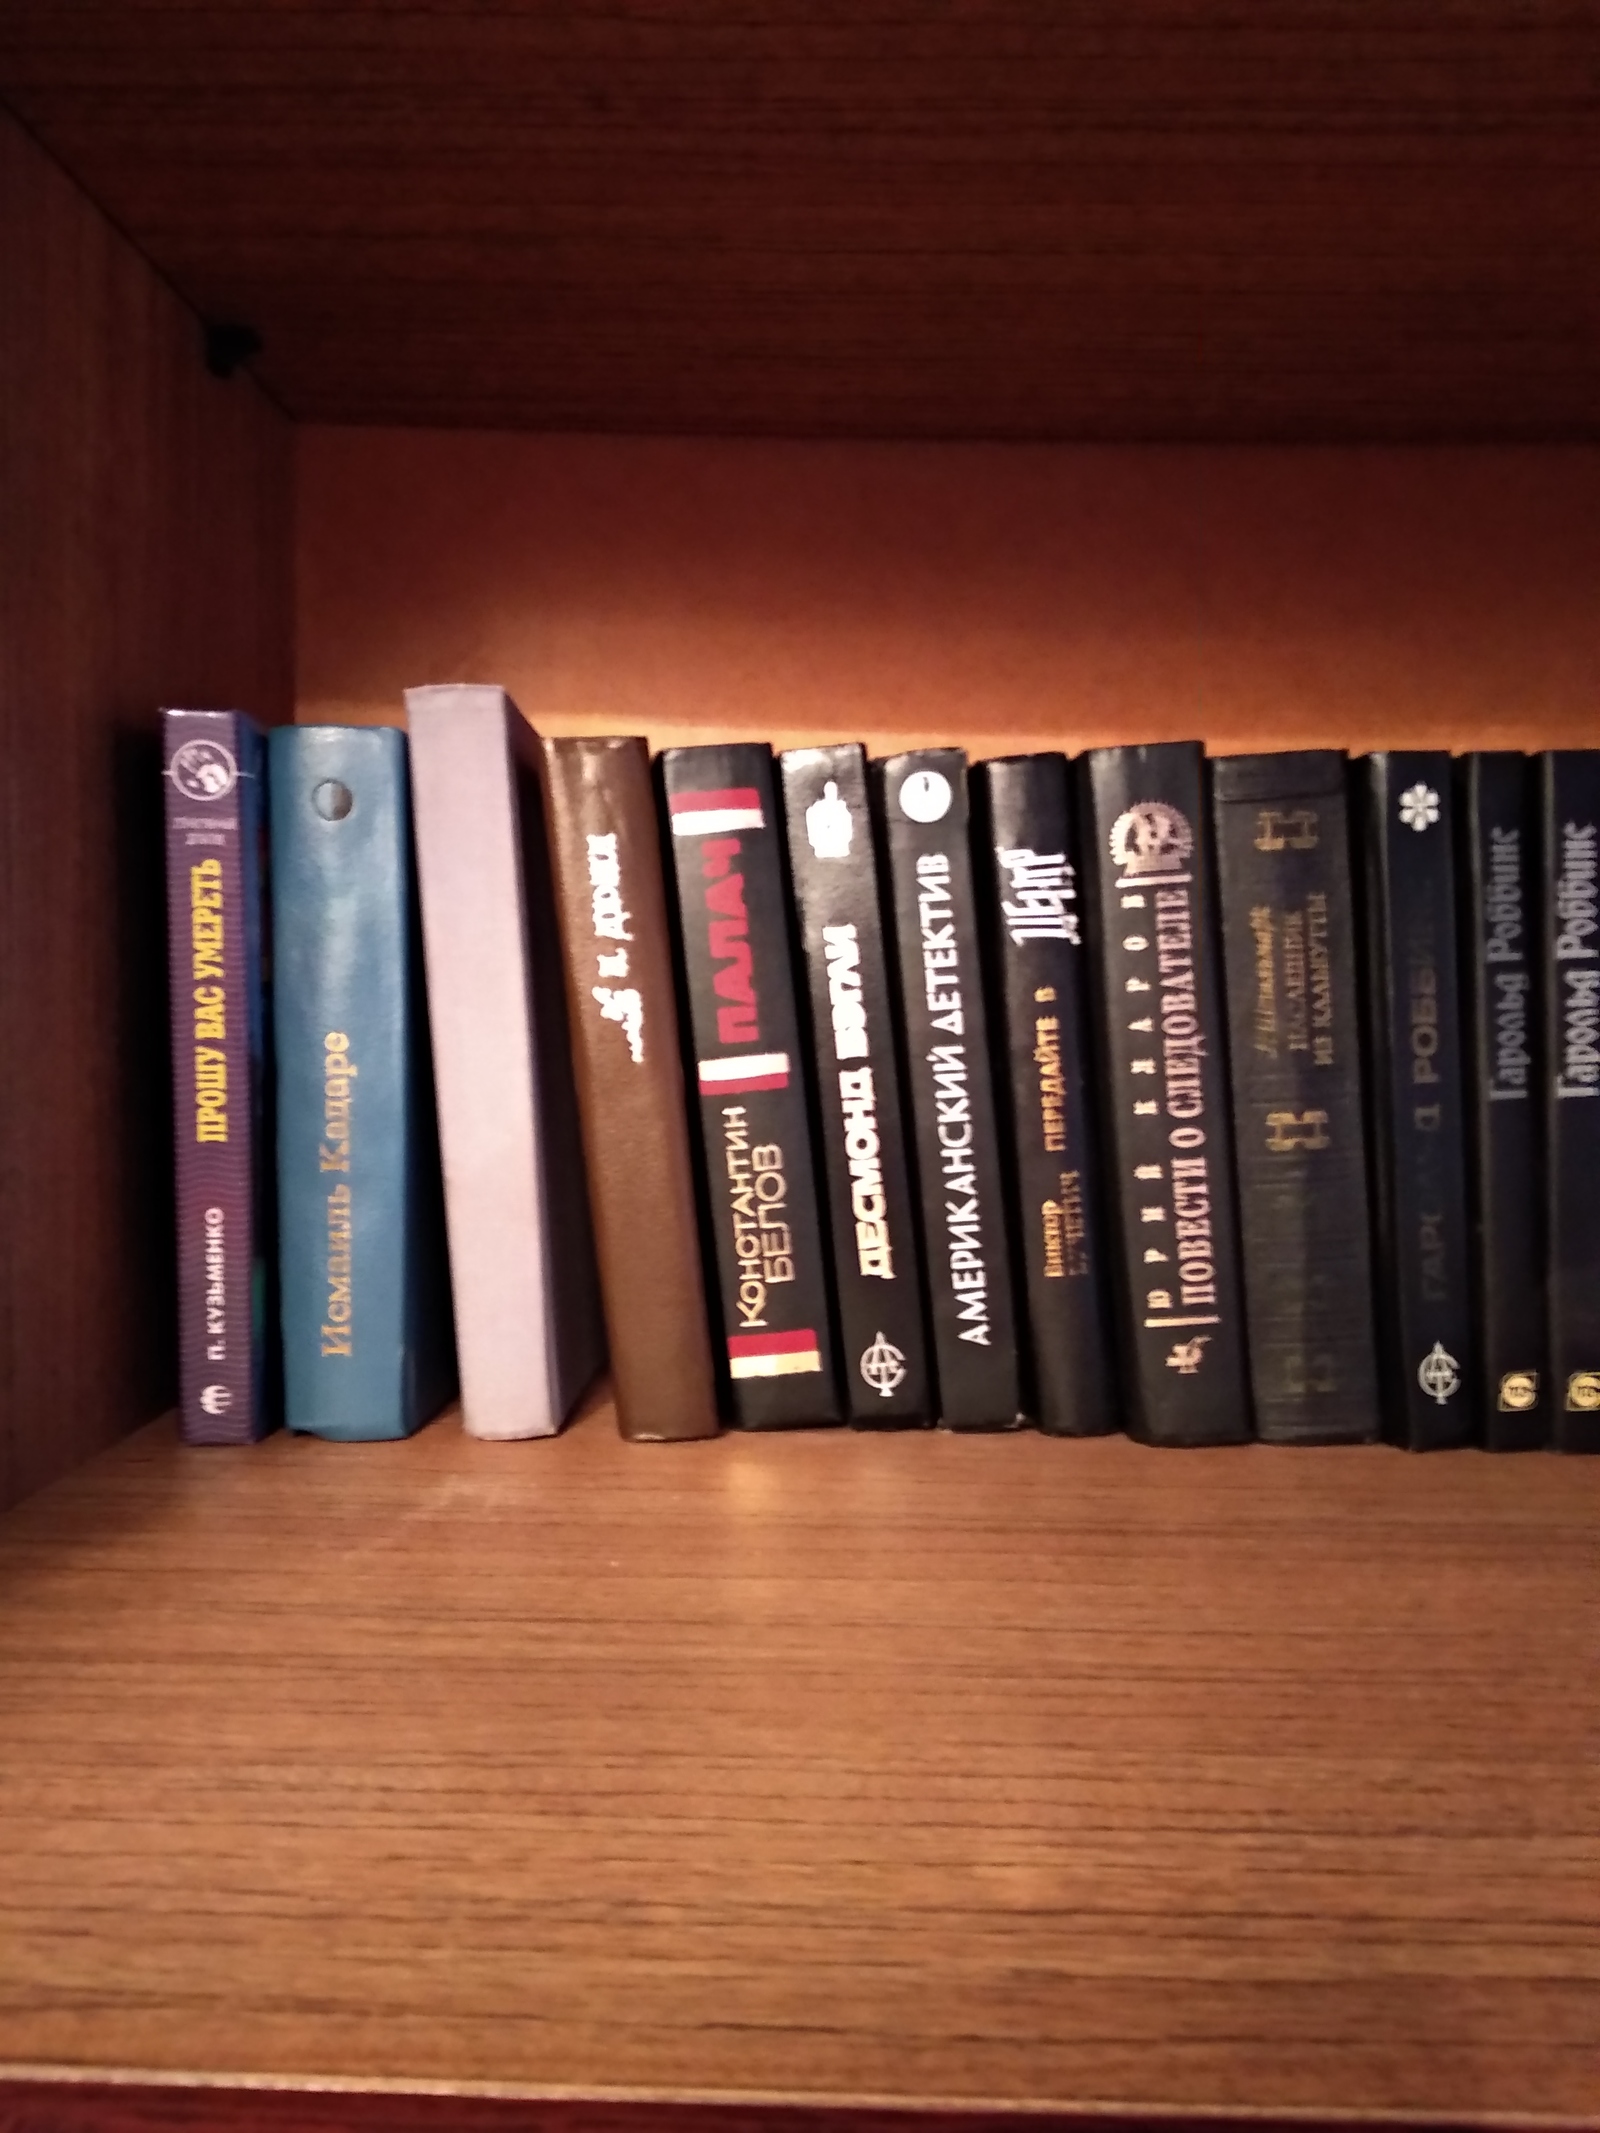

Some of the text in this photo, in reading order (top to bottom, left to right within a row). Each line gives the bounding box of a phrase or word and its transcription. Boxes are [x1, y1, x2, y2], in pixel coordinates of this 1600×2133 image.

[190, 857, 225, 981] УМЕРЕТЬ
[700, 837, 761, 1045] ПАЛАЧ
[1485, 825, 1532, 1100] Гарольд Роббинс
[1556, 819, 1600, 1099] Гарольд Роббинс
[193, 985, 227, 1041] ВАС
[194, 1046, 229, 1143] ПРОШУ
[915, 852, 992, 1347] АМЕРИКАНСКИЙ ДЕТЕКТИВ
[1033, 1015, 1068, 1152] ПЕРЕДАЙТЕ
[1154, 888, 1217, 1306] ПОВЕСТИ О СЛЕДОВАТЕЛЕ
[318, 1031, 359, 1358] Исмаиль Кадаре
[751, 1142, 796, 1285] БЕЛОВ
[838, 1065, 898, 1280] ДЕСМОНД
[1132, 1163, 1174, 1310] ЮРИЙ
[204, 1206, 227, 1362] П. КУЗЬМЕНКО
